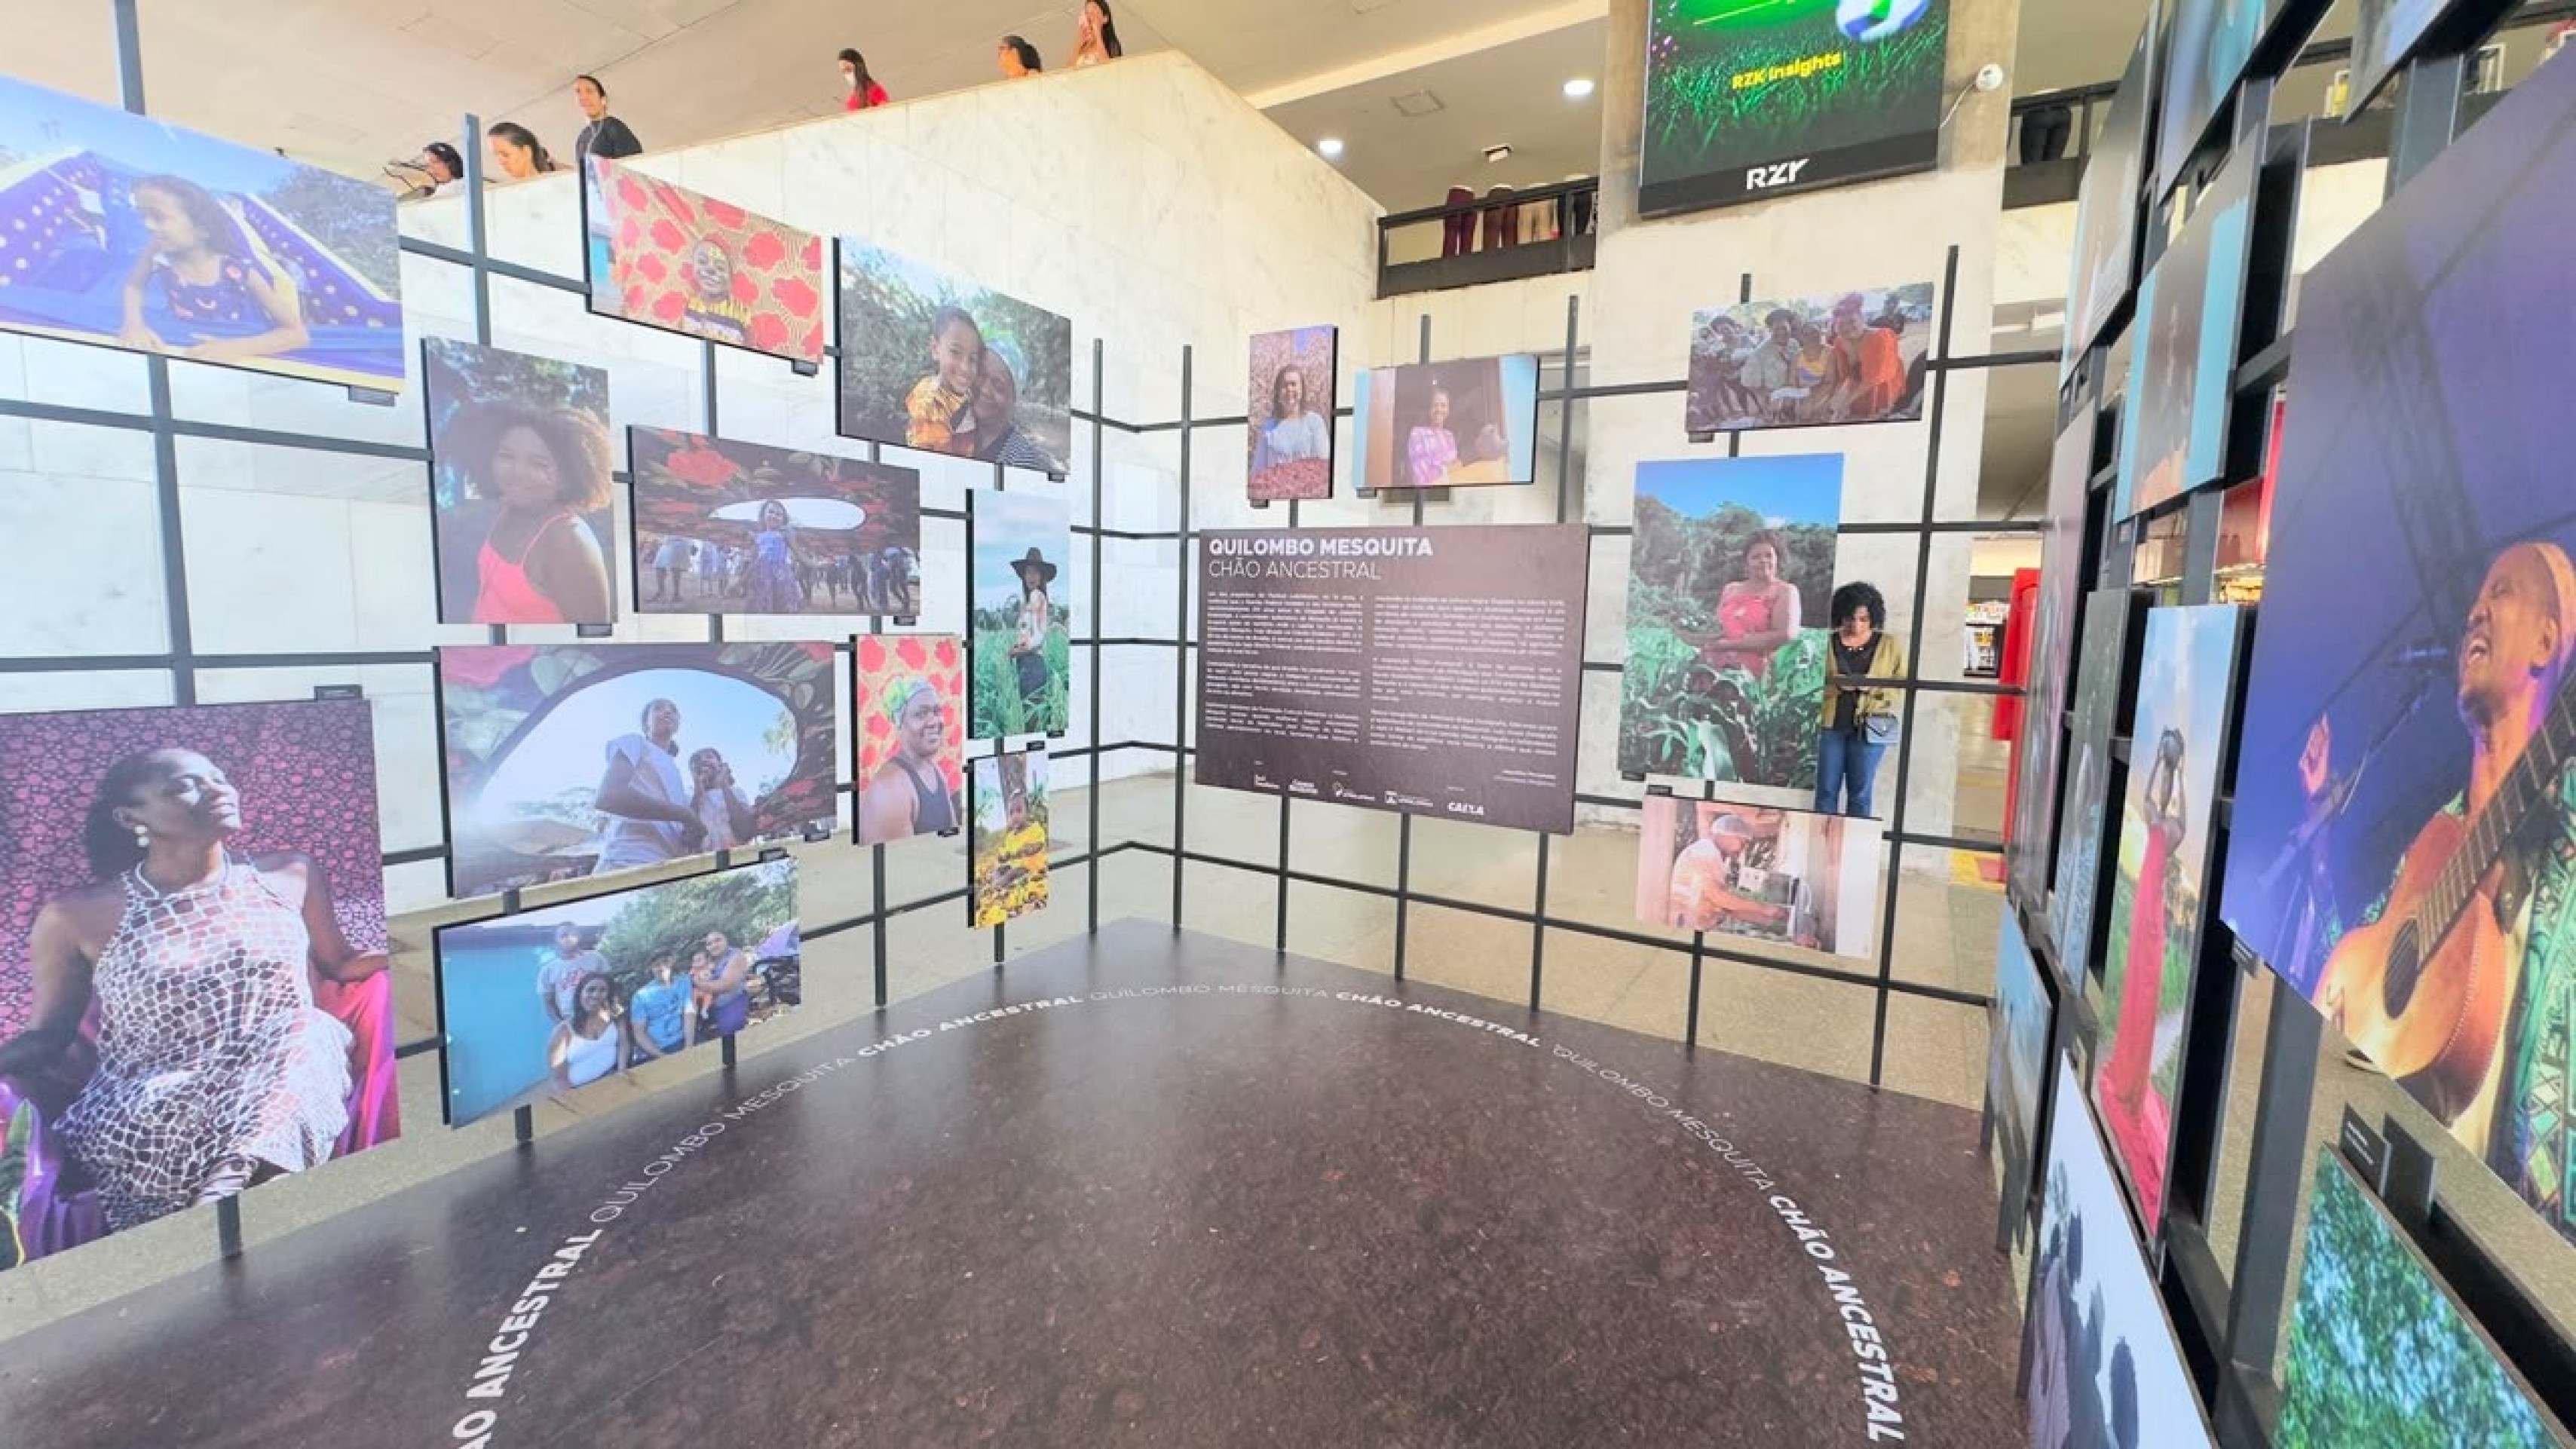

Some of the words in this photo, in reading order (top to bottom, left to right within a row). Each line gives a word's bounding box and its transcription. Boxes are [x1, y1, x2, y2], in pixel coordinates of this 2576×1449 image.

[1769, 52, 1840, 81] Insights
[1208, 538, 1316, 556] QUILOMBO
[1319, 537, 1434, 556] MESQUITA
[1208, 557, 1260, 578] CHÃO
[1266, 561, 1382, 580] ANCESTRAL
[466, 1229, 602, 1398] ANCESTRAL
[590, 1122, 725, 1224] QUILOMBO
[724, 1058, 857, 1120] MESQUITA
[939, 995, 1085, 1031] ANCESTRAL
[1090, 984, 1210, 1000] QUILOMBO
[1218, 984, 1328, 998] MESQUITA
[1405, 1003, 1541, 1047] ANCESTRAL
[1553, 1043, 1669, 1107] QUILOMBO
[1665, 1108, 1775, 1190] MESQUITA
[1769, 1194, 1834, 1260] CHÃO
[1817, 1264, 1906, 1443] ANCESTRAL
